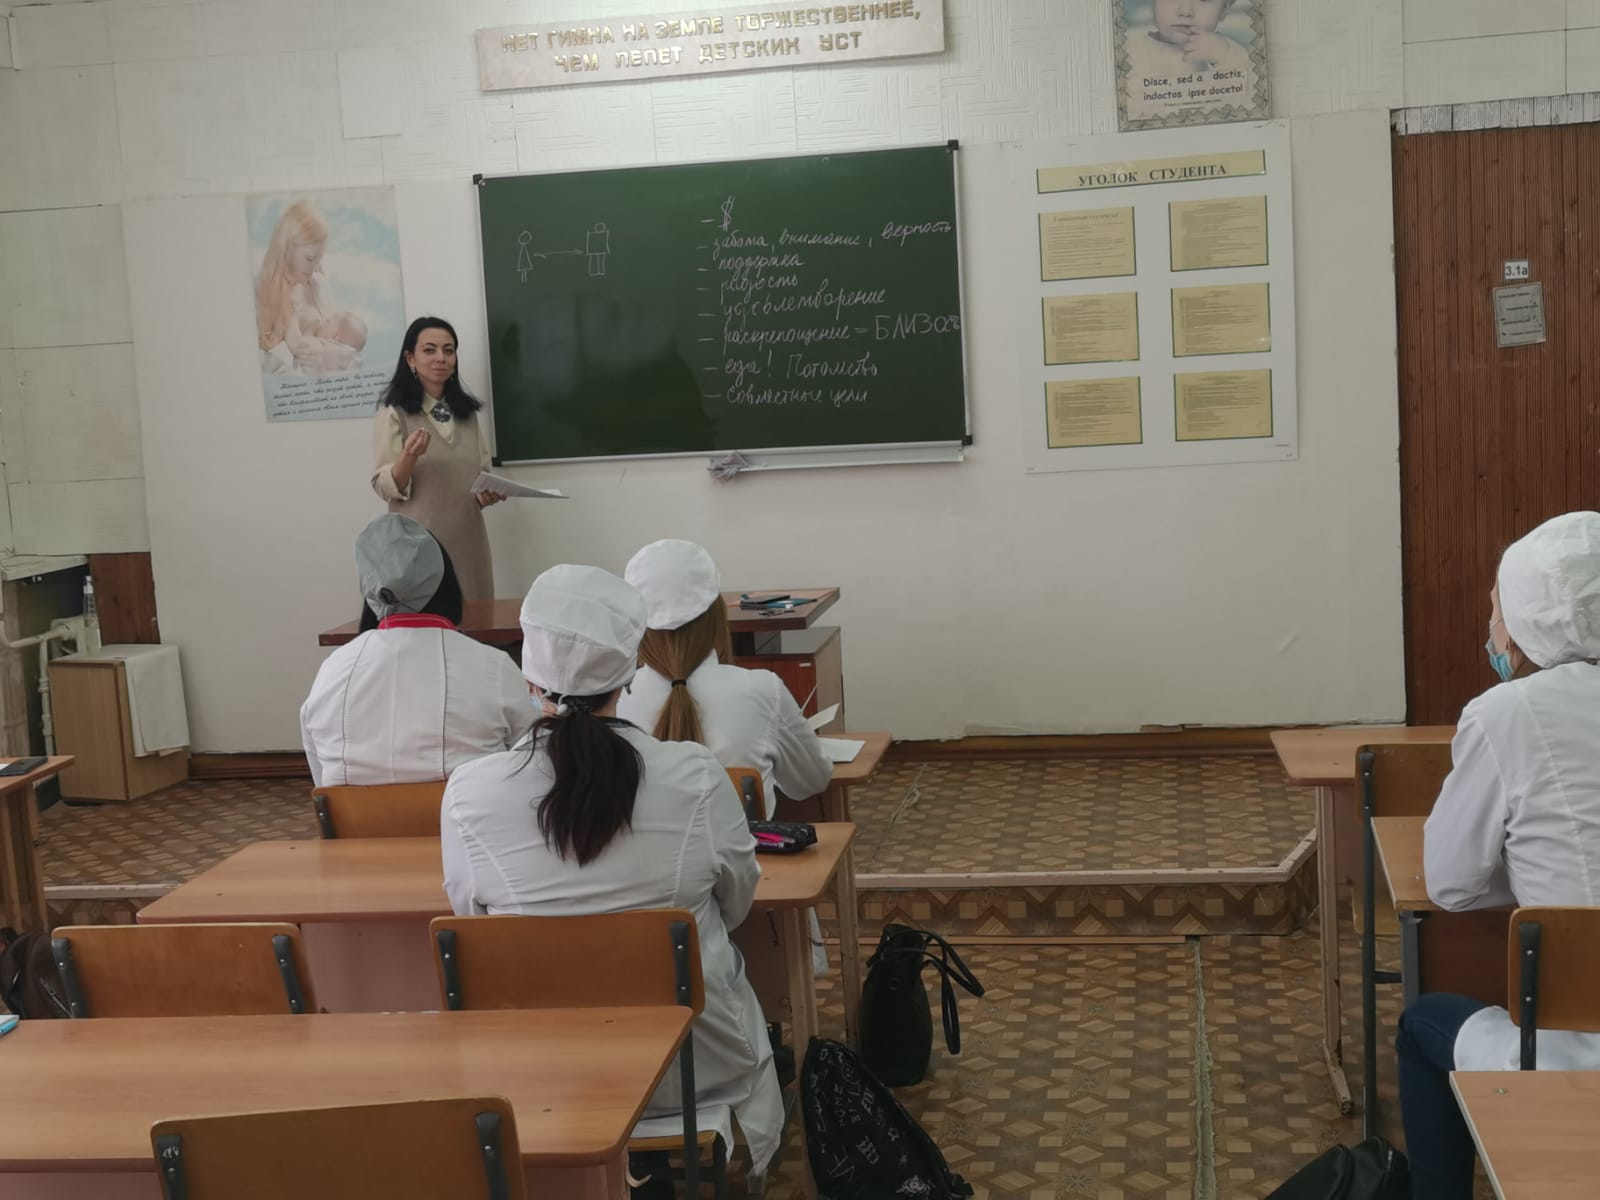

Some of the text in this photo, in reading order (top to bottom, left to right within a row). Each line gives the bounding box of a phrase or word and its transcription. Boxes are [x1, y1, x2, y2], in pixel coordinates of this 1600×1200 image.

[501, 32, 539, 53] НЕТ
[546, 25, 615, 48] ГИМНА
[622, 21, 650, 42] НА
[734, 0, 921, 32] ТОРЖЕСТВЕННЕЕ,
[553, 52, 600, 73] ЧЕМ
[698, 37, 800, 65] ДЕТСКИХ
[818, 31, 863, 52] УСТ
[1176, 74, 1193, 85] sed
[1143, 89, 1183, 101] indoctos
[1187, 87, 1207, 98] ipse
[1077, 164, 1227, 187] УГОЛОК СТУДЕНТА
[881, 221, 952, 247] верность
[718, 253, 805, 282] поддержка
[720, 274, 799, 304] радость
[786, 352, 878, 379] Потомство
